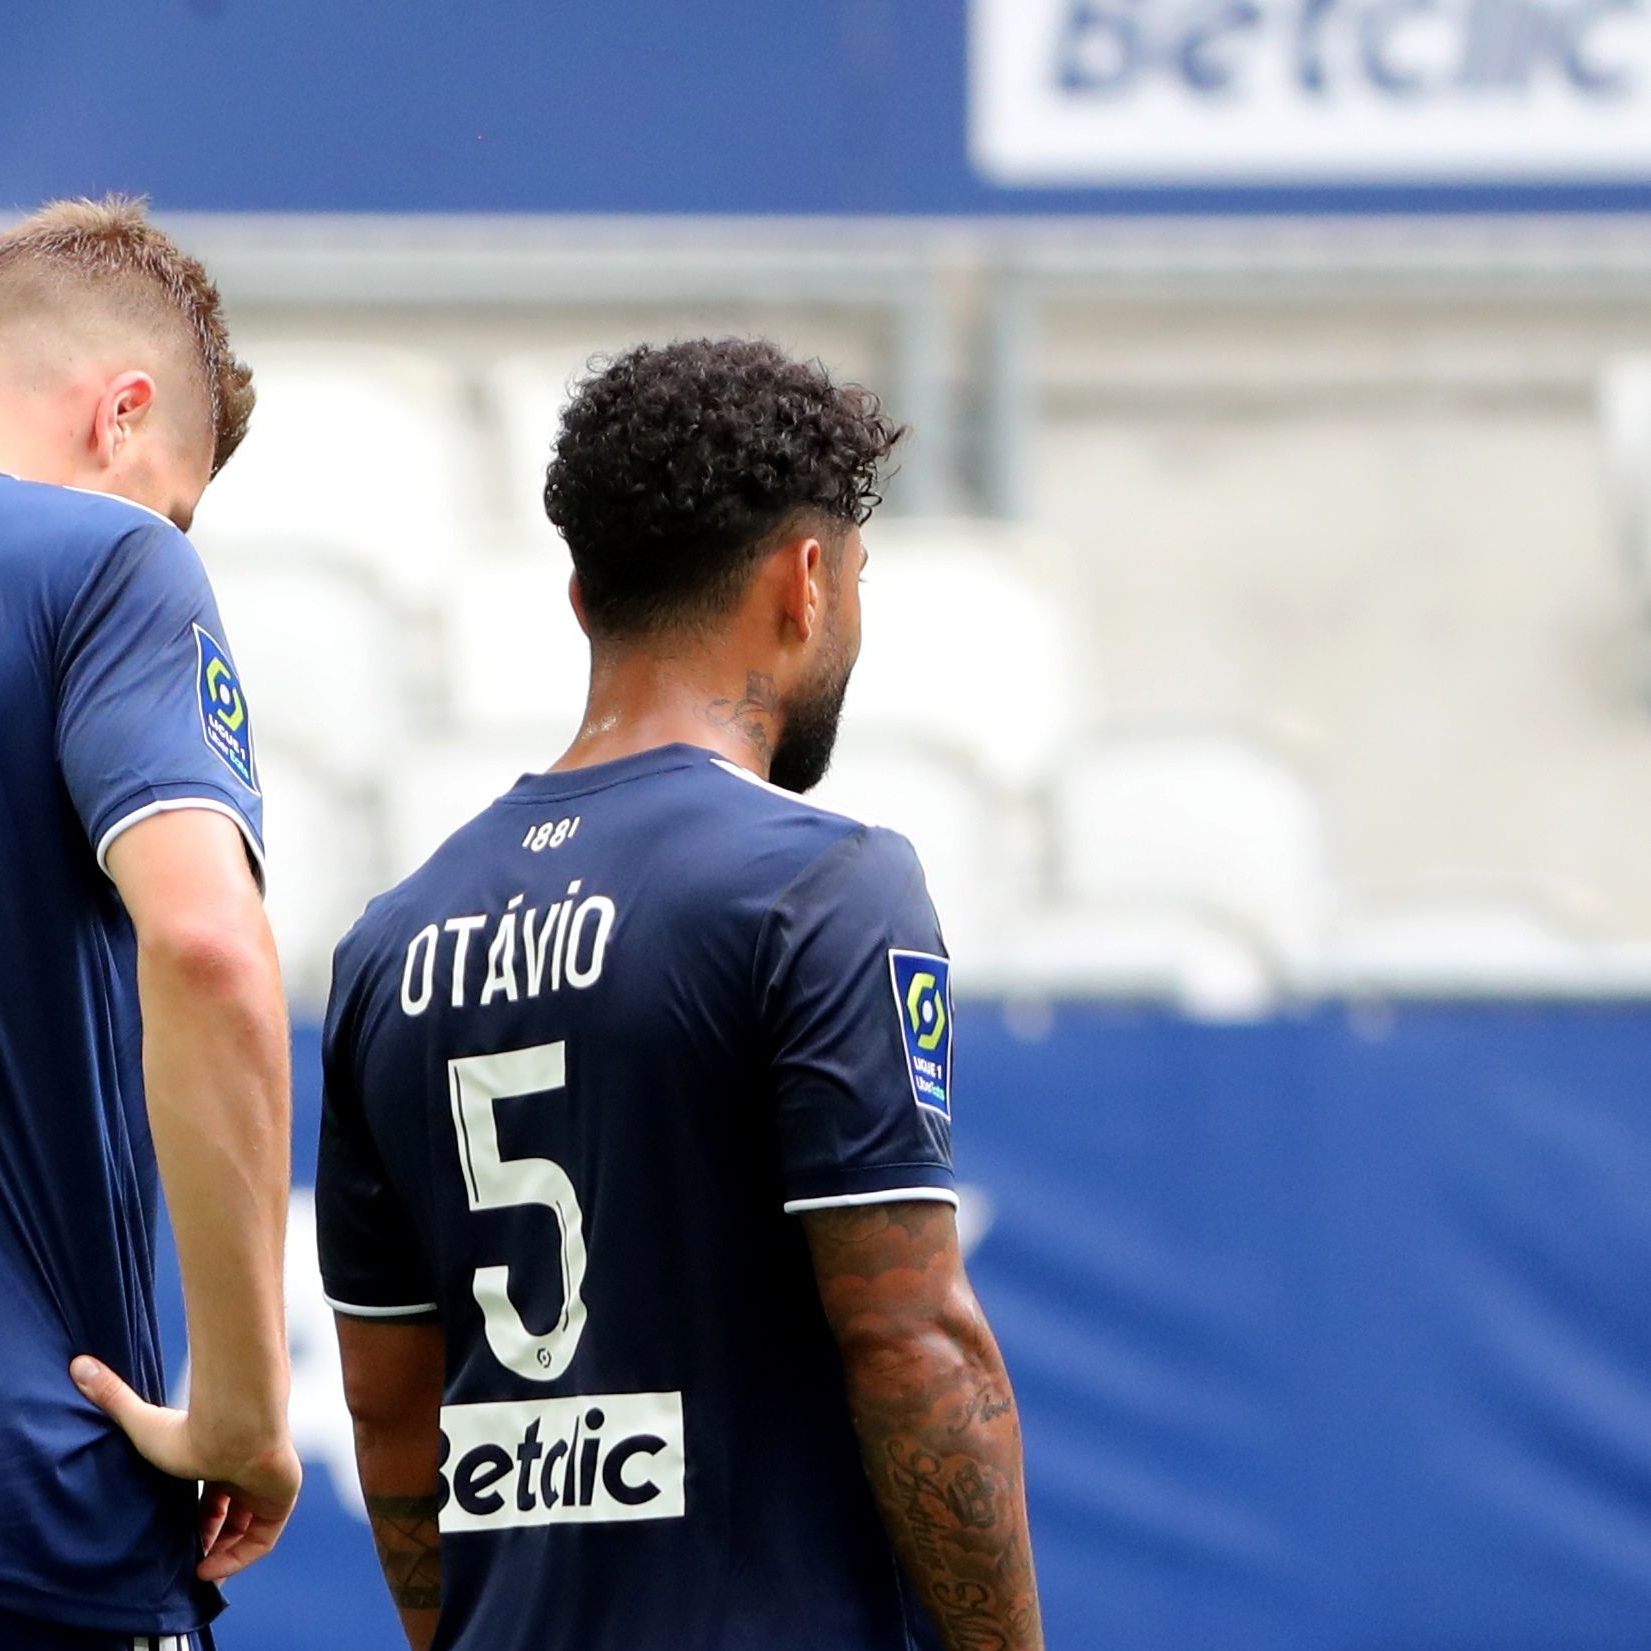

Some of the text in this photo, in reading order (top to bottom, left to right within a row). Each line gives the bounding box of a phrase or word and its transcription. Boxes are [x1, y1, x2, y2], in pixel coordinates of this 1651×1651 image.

[522, 816, 580, 852] 1881
[448, 1040, 587, 1381] 5
[439, 1407, 667, 1516] etclic
